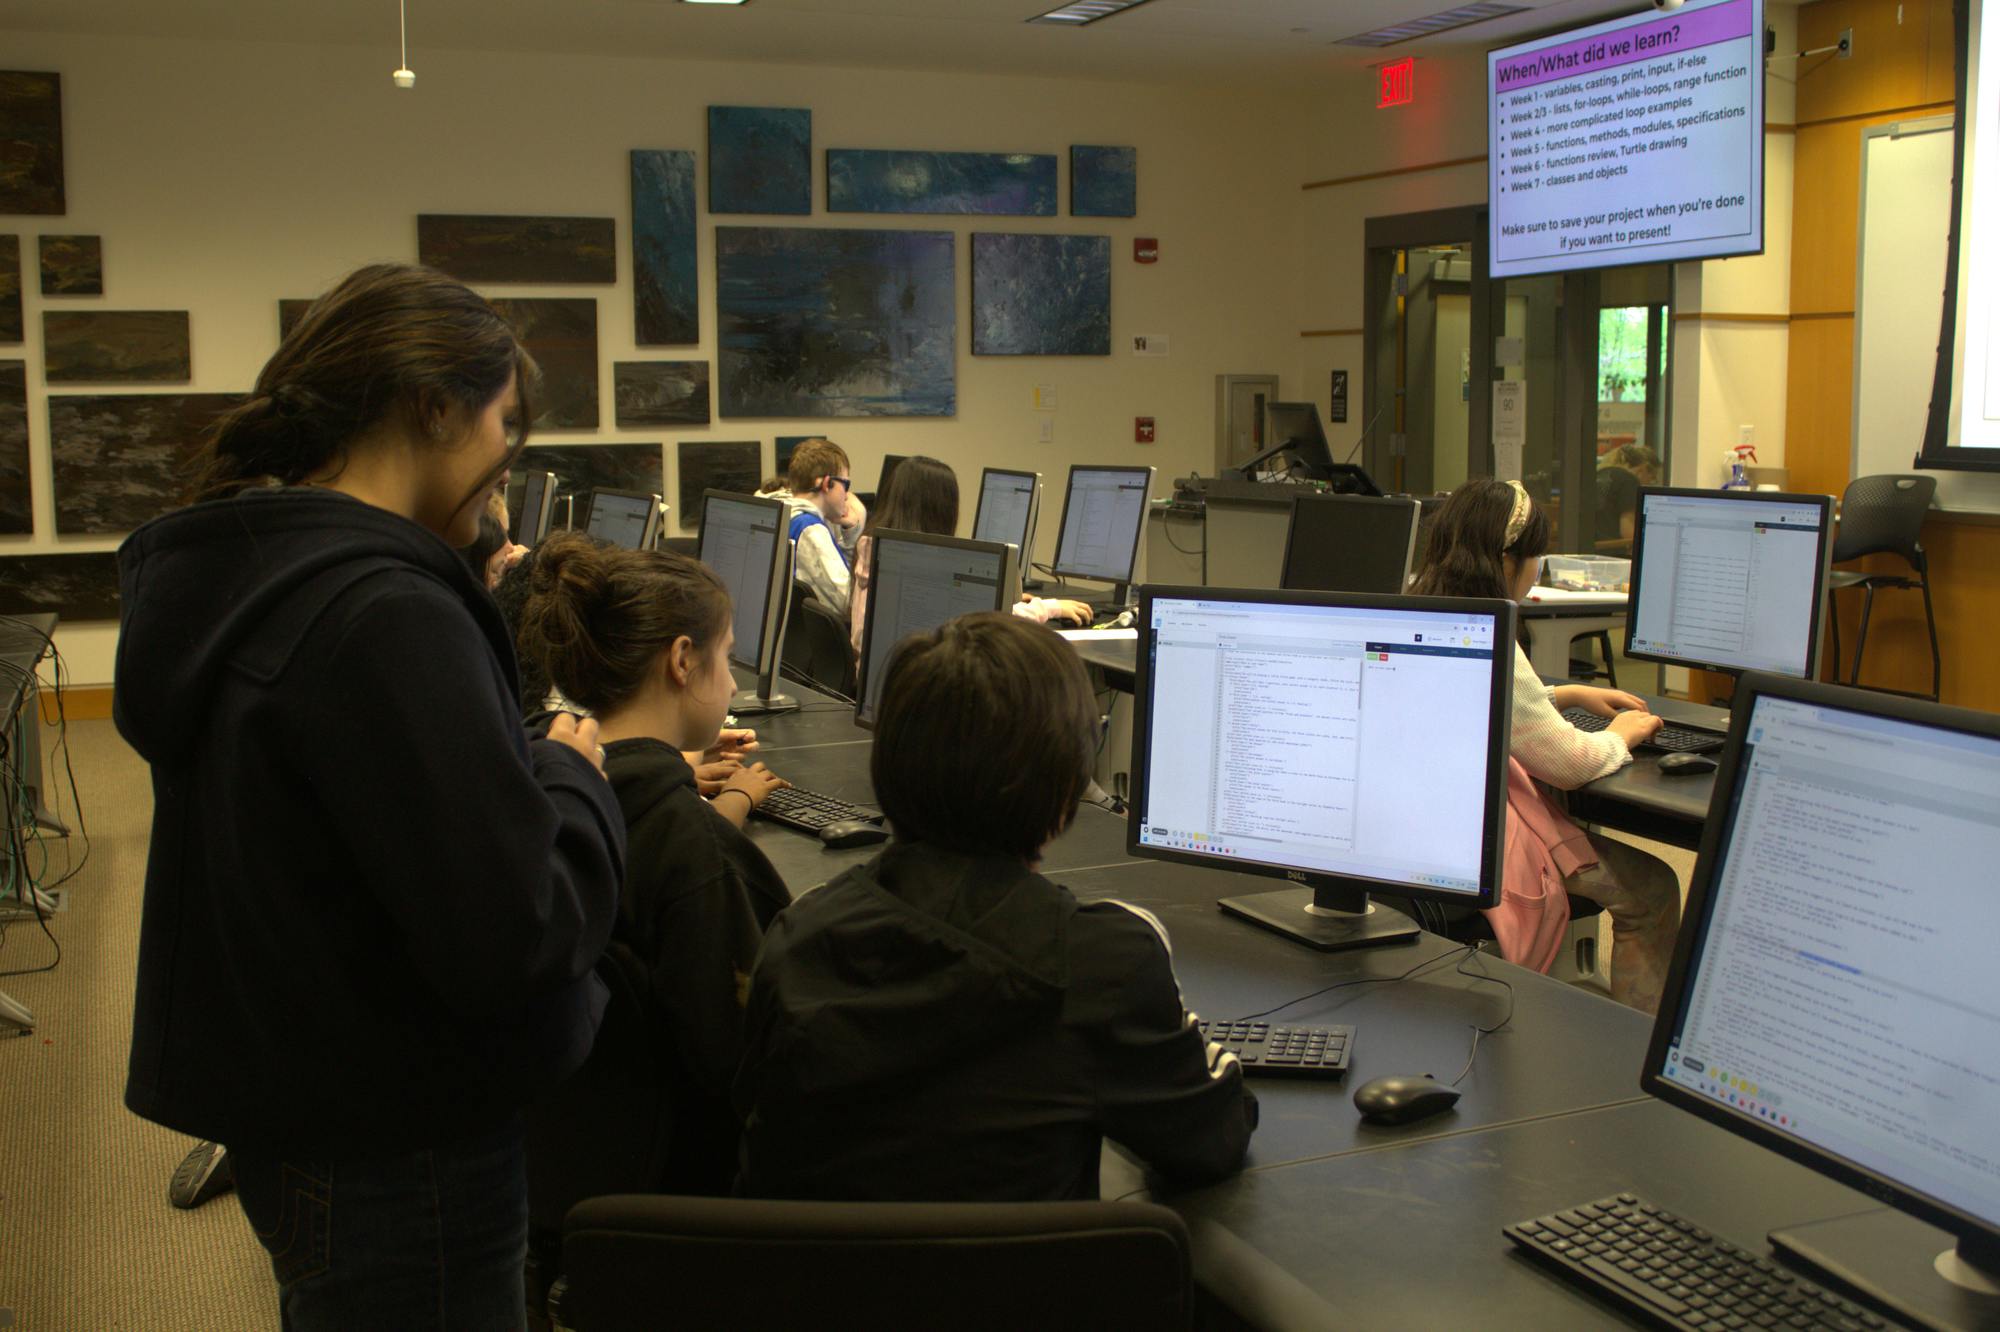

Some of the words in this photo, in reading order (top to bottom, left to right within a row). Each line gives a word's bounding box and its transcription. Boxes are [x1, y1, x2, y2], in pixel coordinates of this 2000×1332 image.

[1499, 53, 1579, 83] When/What
[1583, 43, 1605, 64] did
[1609, 41, 1630, 57] we
[1635, 25, 1680, 51] learn?
[1382, 63, 1407, 102] EXIT
[1510, 94, 1532, 106] Week
[1544, 82, 1584, 98] variables,
[1585, 74, 1620, 90] casting,
[1621, 69, 1646, 84] print,
[1648, 63, 1675, 77] input,
[1677, 54, 1707, 70] if-else
[1510, 111, 1532, 123] Week
[1534, 107, 1547, 118] 2/3
[1553, 102, 1573, 115] lists,
[1574, 94, 1615, 110] for-loops,
[1617, 82, 1672, 101] while-loops,
[1673, 76, 1701, 90] range
[1704, 66, 1747, 84] function
[1510, 128, 1532, 140] Week
[1534, 126, 1540, 136] 4
[1546, 122, 1568, 133] more
[1570, 110, 1623, 130] complicated
[1625, 107, 1646, 119] loop
[1647, 96, 1693, 113] examples
[1510, 146, 1532, 158] Week
[1534, 145, 1540, 153] 5
[1546, 136, 1588, 152] functions,
[1589, 127, 1631, 143] methods,
[1632, 119, 1675, 135] modules,
[1676, 106, 1746, 128] specifications
[1510, 163, 1532, 175] Week
[1534, 161, 1540, 170] 6
[1546, 153, 1586, 169] functions
[1587, 149, 1619, 161] review,
[1620, 142, 1647, 156] Turtle
[1649, 136, 1688, 151] drawing
[1510, 180, 1533, 192] Week
[1534, 178, 1540, 187] 7
[1546, 174, 1576, 187] classes
[1577, 170, 1594, 181] and
[1595, 164, 1628, 179] objects
[1502, 223, 1525, 236] Make
[1527, 221, 1547, 233] sure
[1549, 219, 1559, 230] to
[1560, 217, 1582, 229] save
[1583, 214, 1606, 228] your
[1607, 206, 1644, 225] project
[1646, 204, 1676, 217] when
[1678, 198, 1712, 216] you're
[1715, 194, 1745, 208] done
[1560, 236, 1567, 248] if
[1568, 236, 1586, 250] you
[1588, 232, 1613, 246] want
[1615, 230, 1626, 242] to
[1628, 224, 1672, 243] present!
